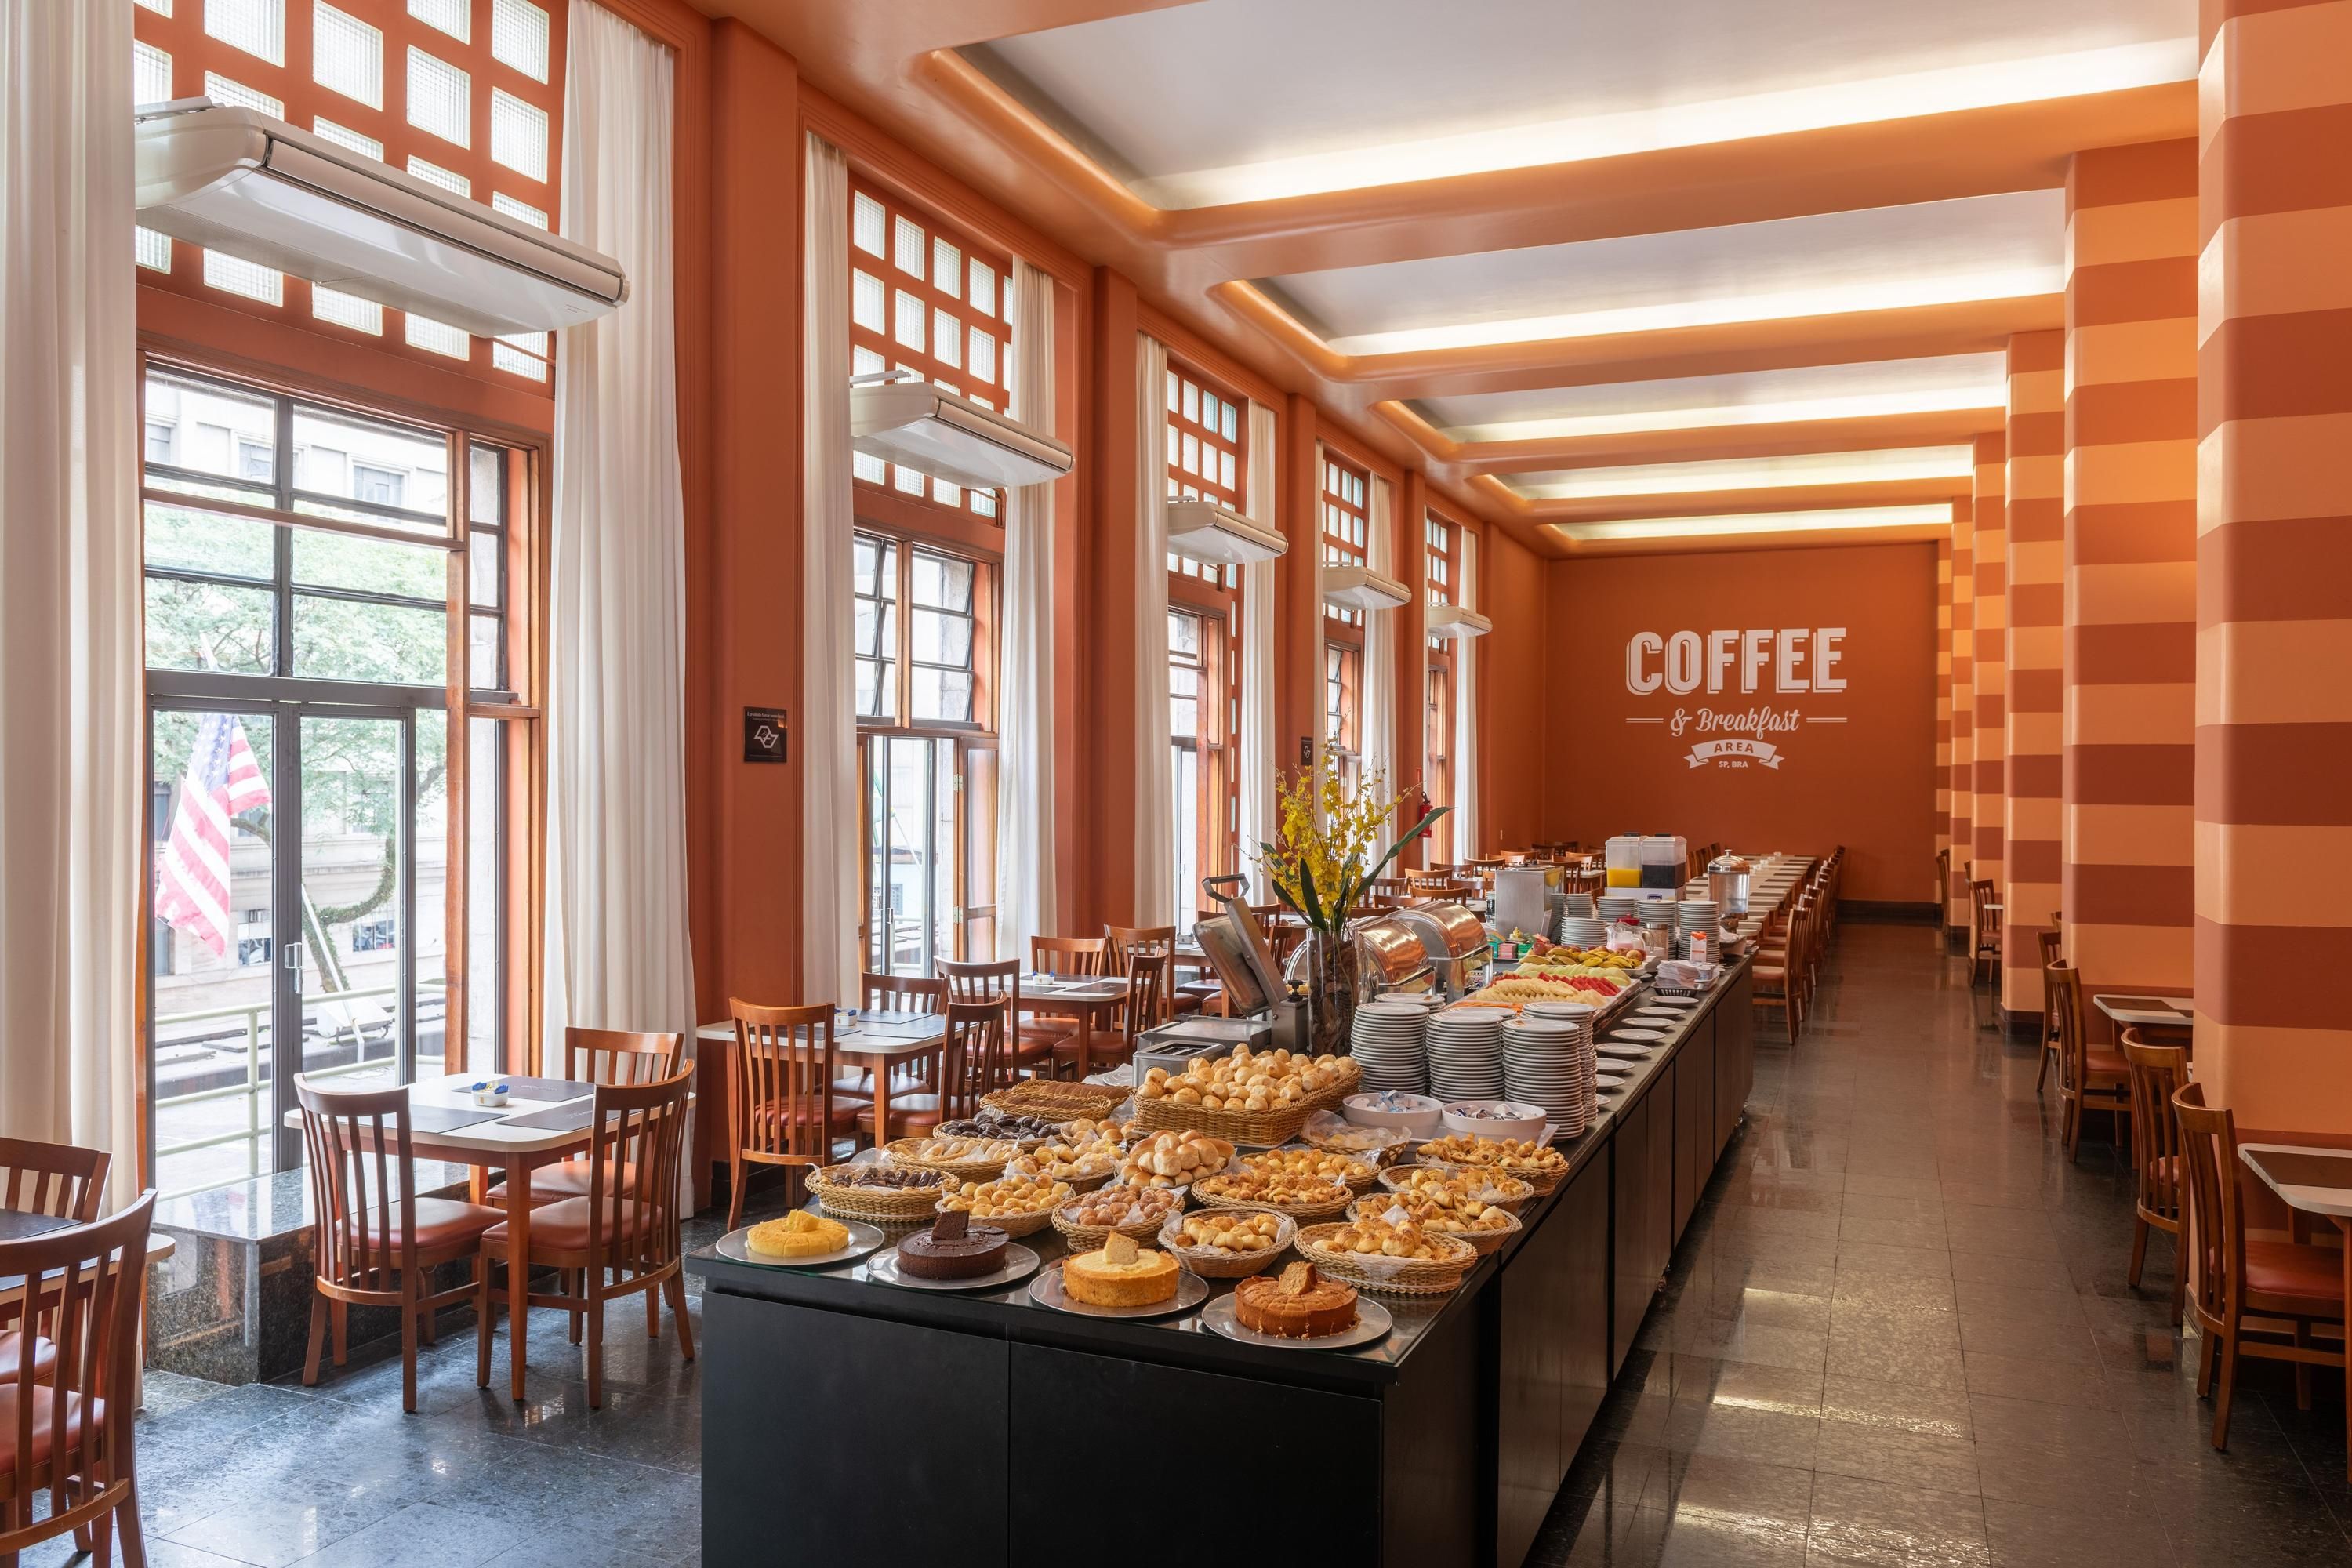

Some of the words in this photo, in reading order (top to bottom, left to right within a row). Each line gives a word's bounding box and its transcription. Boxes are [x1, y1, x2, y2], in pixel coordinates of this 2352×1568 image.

[1625, 627, 1847, 695] COFFEE
[1670, 708, 1693, 737] &
[1695, 706, 1801, 740] Breakfast
[1714, 742, 1754, 753] AREA
